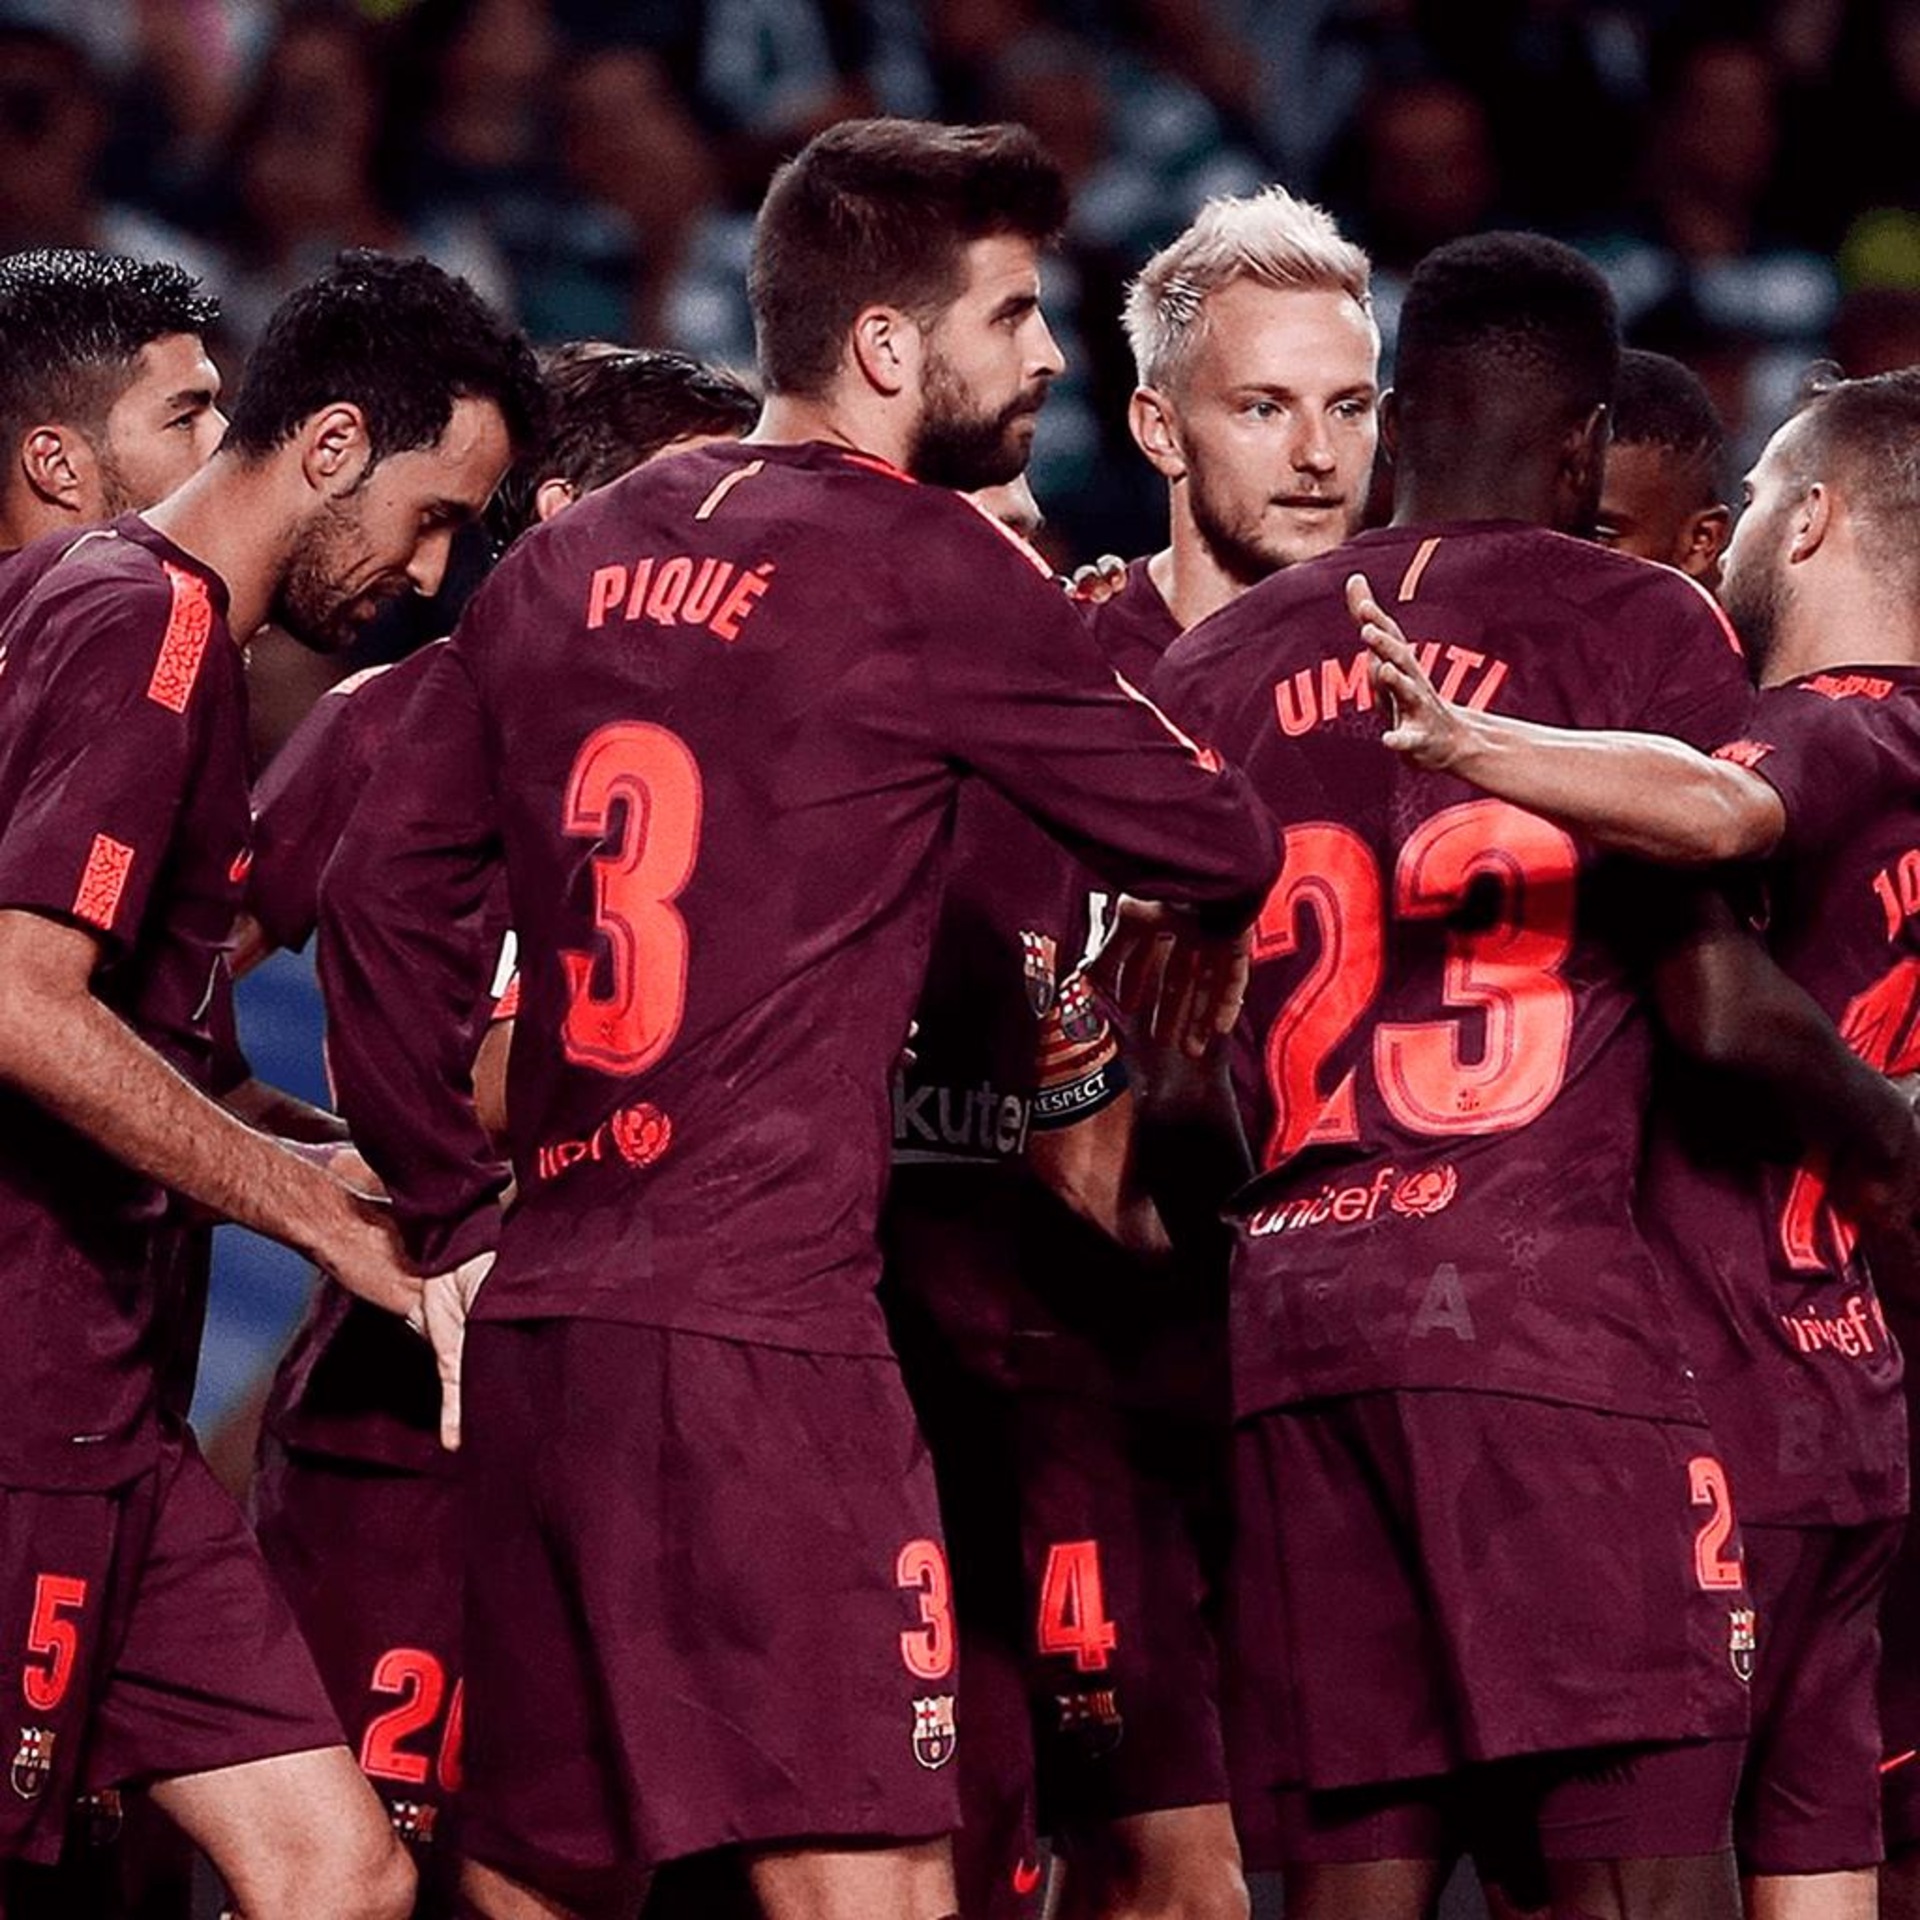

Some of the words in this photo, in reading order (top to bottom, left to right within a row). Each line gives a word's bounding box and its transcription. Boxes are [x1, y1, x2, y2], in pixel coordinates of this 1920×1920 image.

[585, 555, 775, 642] PIQUÉ
[1274, 641, 1509, 737] UMITI
[560, 720, 704, 1076] 3
[1250, 798, 1579, 1169] 23
[893, 1068, 1032, 1154] kute
[1250, 1167, 1394, 1237] unicef
[23, 1573, 87, 1711] 5
[897, 1539, 955, 1681] 3
[1038, 1540, 1118, 1672] 4
